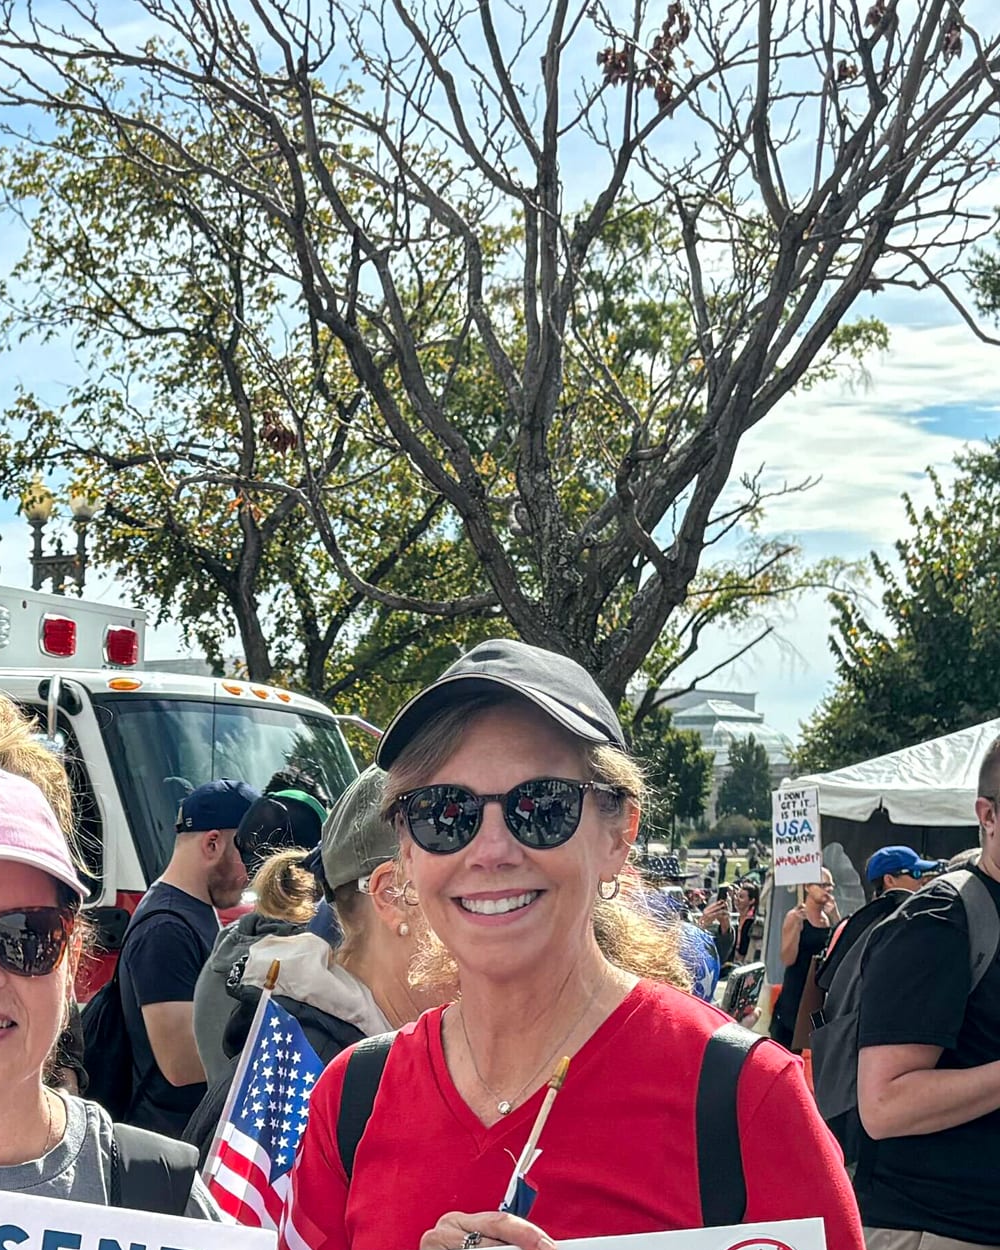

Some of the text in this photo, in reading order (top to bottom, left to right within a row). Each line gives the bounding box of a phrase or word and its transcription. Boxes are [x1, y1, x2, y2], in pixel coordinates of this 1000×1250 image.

[781, 801, 796, 810] GET
[781, 808, 807, 820] IS THE
[775, 819, 812, 836] USA
[787, 846, 801, 855] OR
